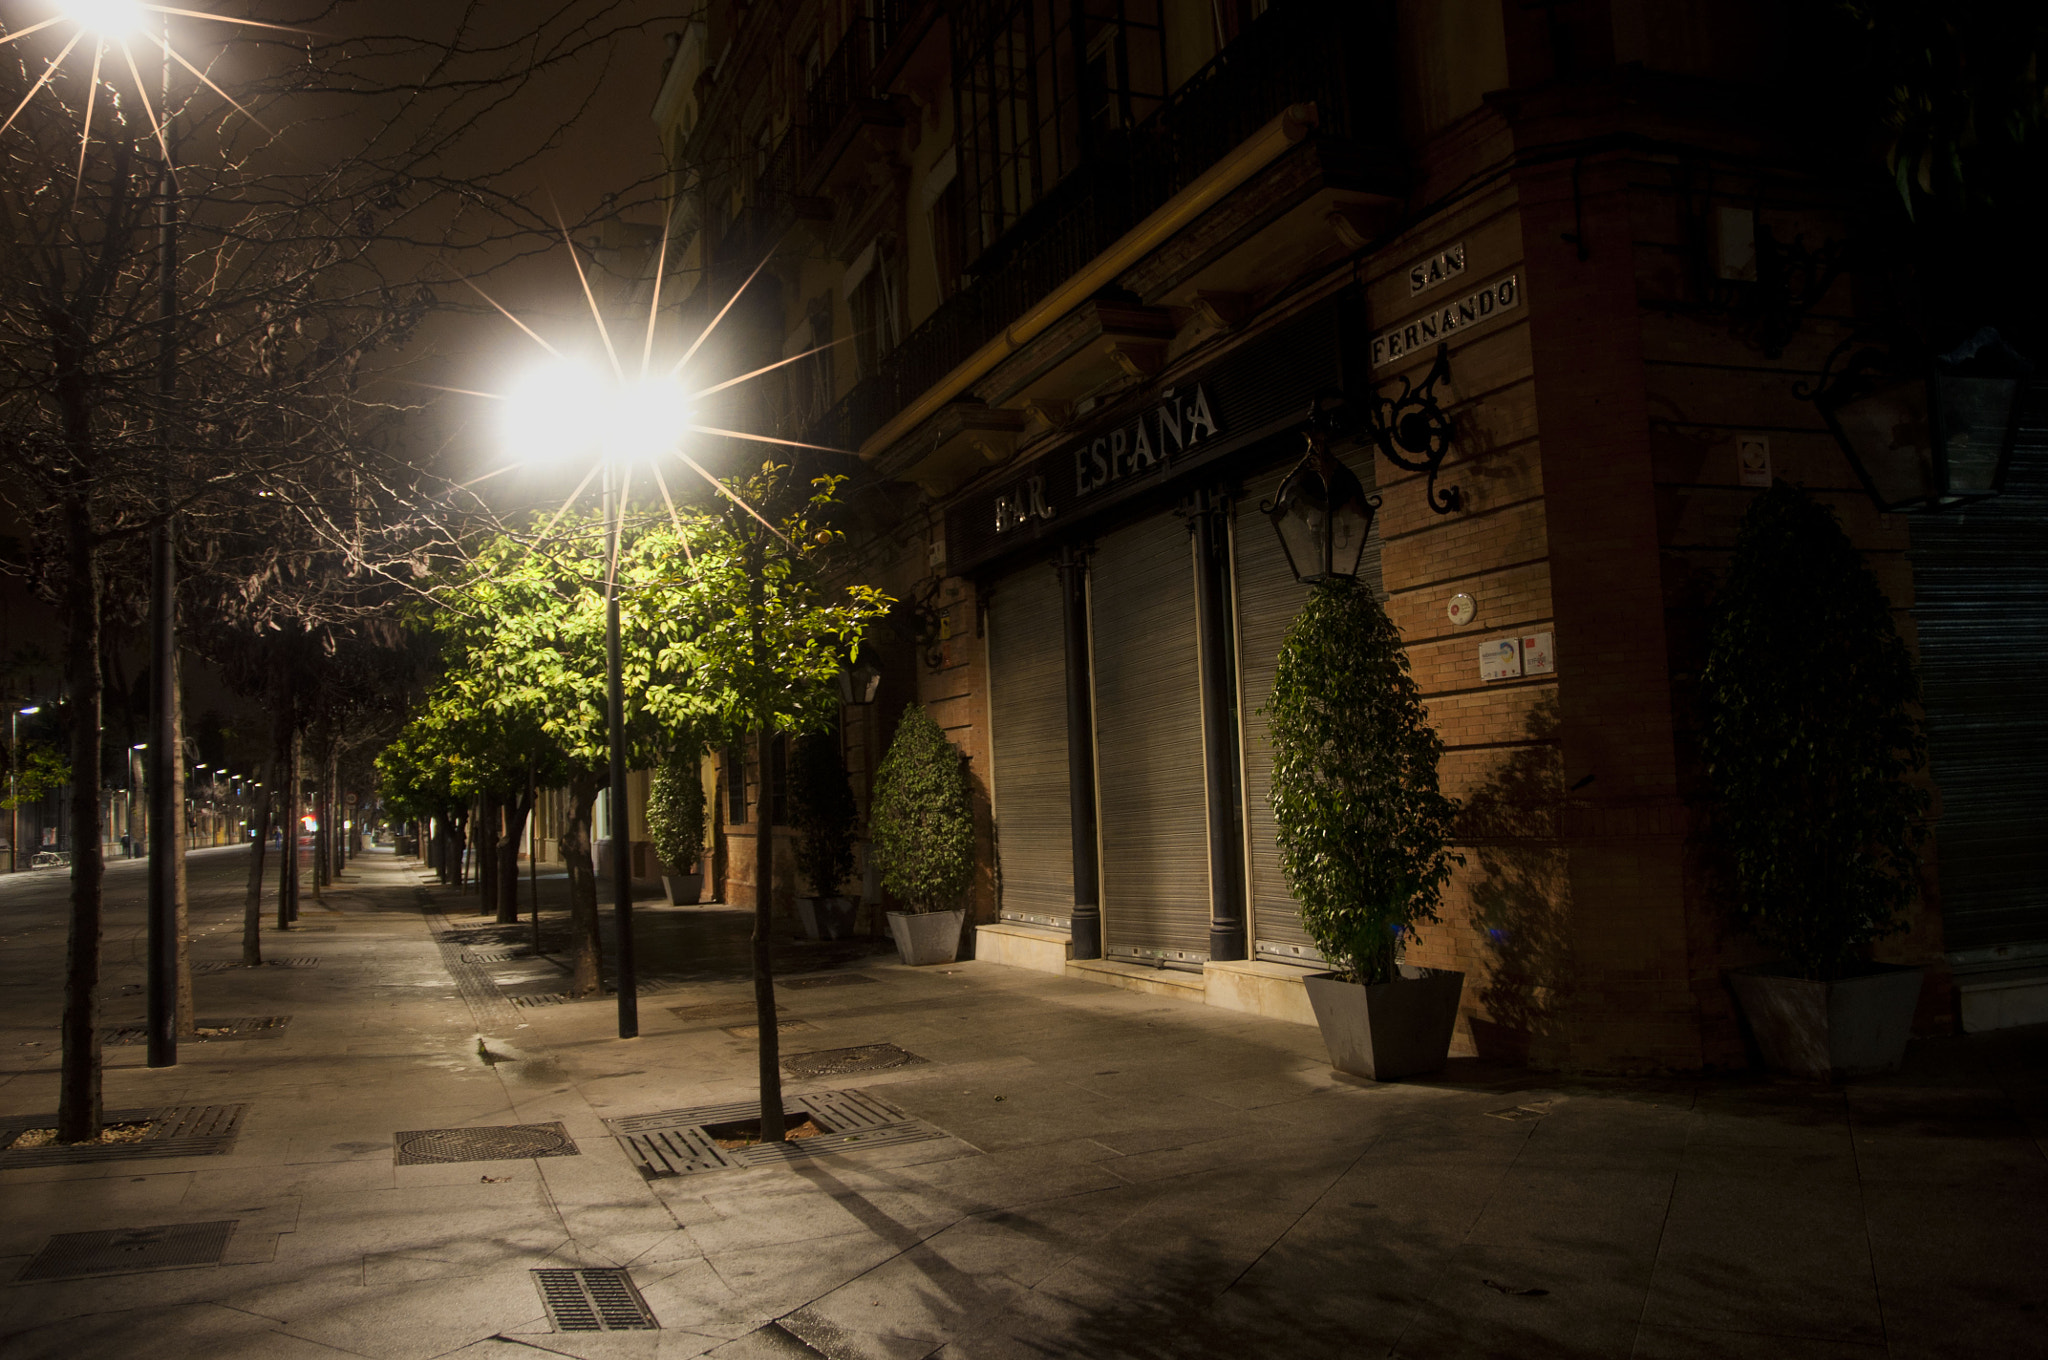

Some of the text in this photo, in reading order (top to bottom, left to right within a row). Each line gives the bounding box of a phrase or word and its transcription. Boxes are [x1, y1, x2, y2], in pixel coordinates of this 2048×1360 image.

[1411, 247, 1463, 291] SAN
[1373, 281, 1514, 363] FERNANDO
[995, 381, 1219, 533] BAR ESPAÑA
